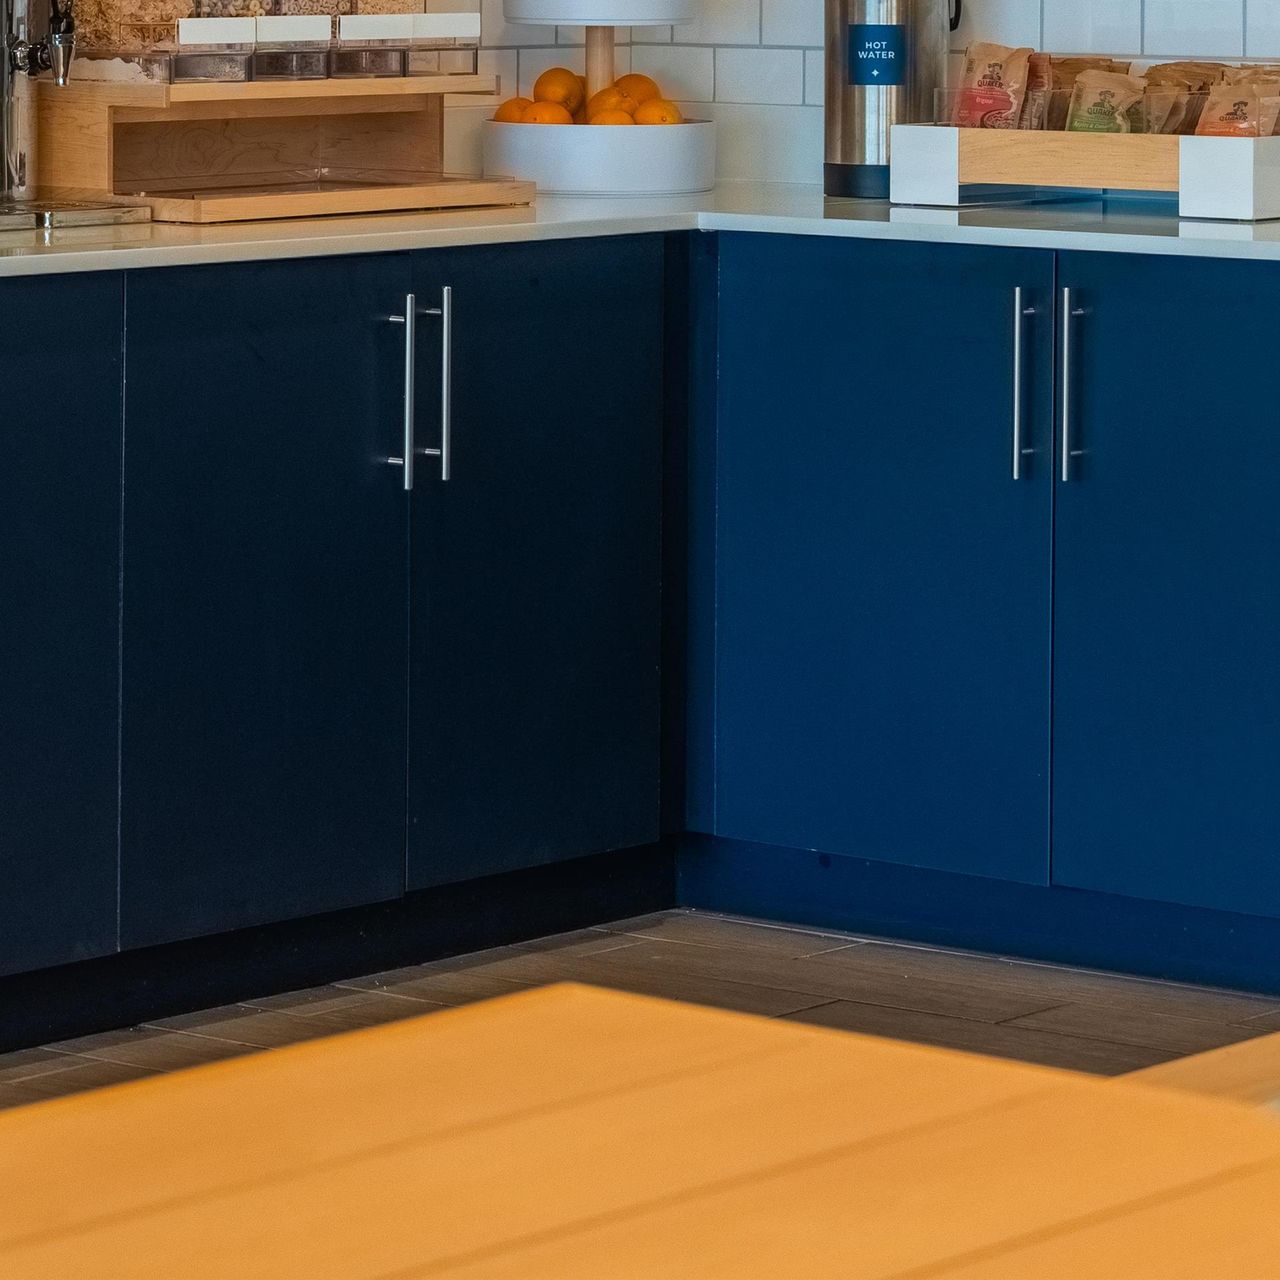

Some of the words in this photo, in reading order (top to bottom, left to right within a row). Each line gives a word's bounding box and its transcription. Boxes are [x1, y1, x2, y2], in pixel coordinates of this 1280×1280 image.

[865, 41, 887, 49] HOT
[857, 51, 895, 59] WATER
[977, 79, 1004, 88] QUAKER
